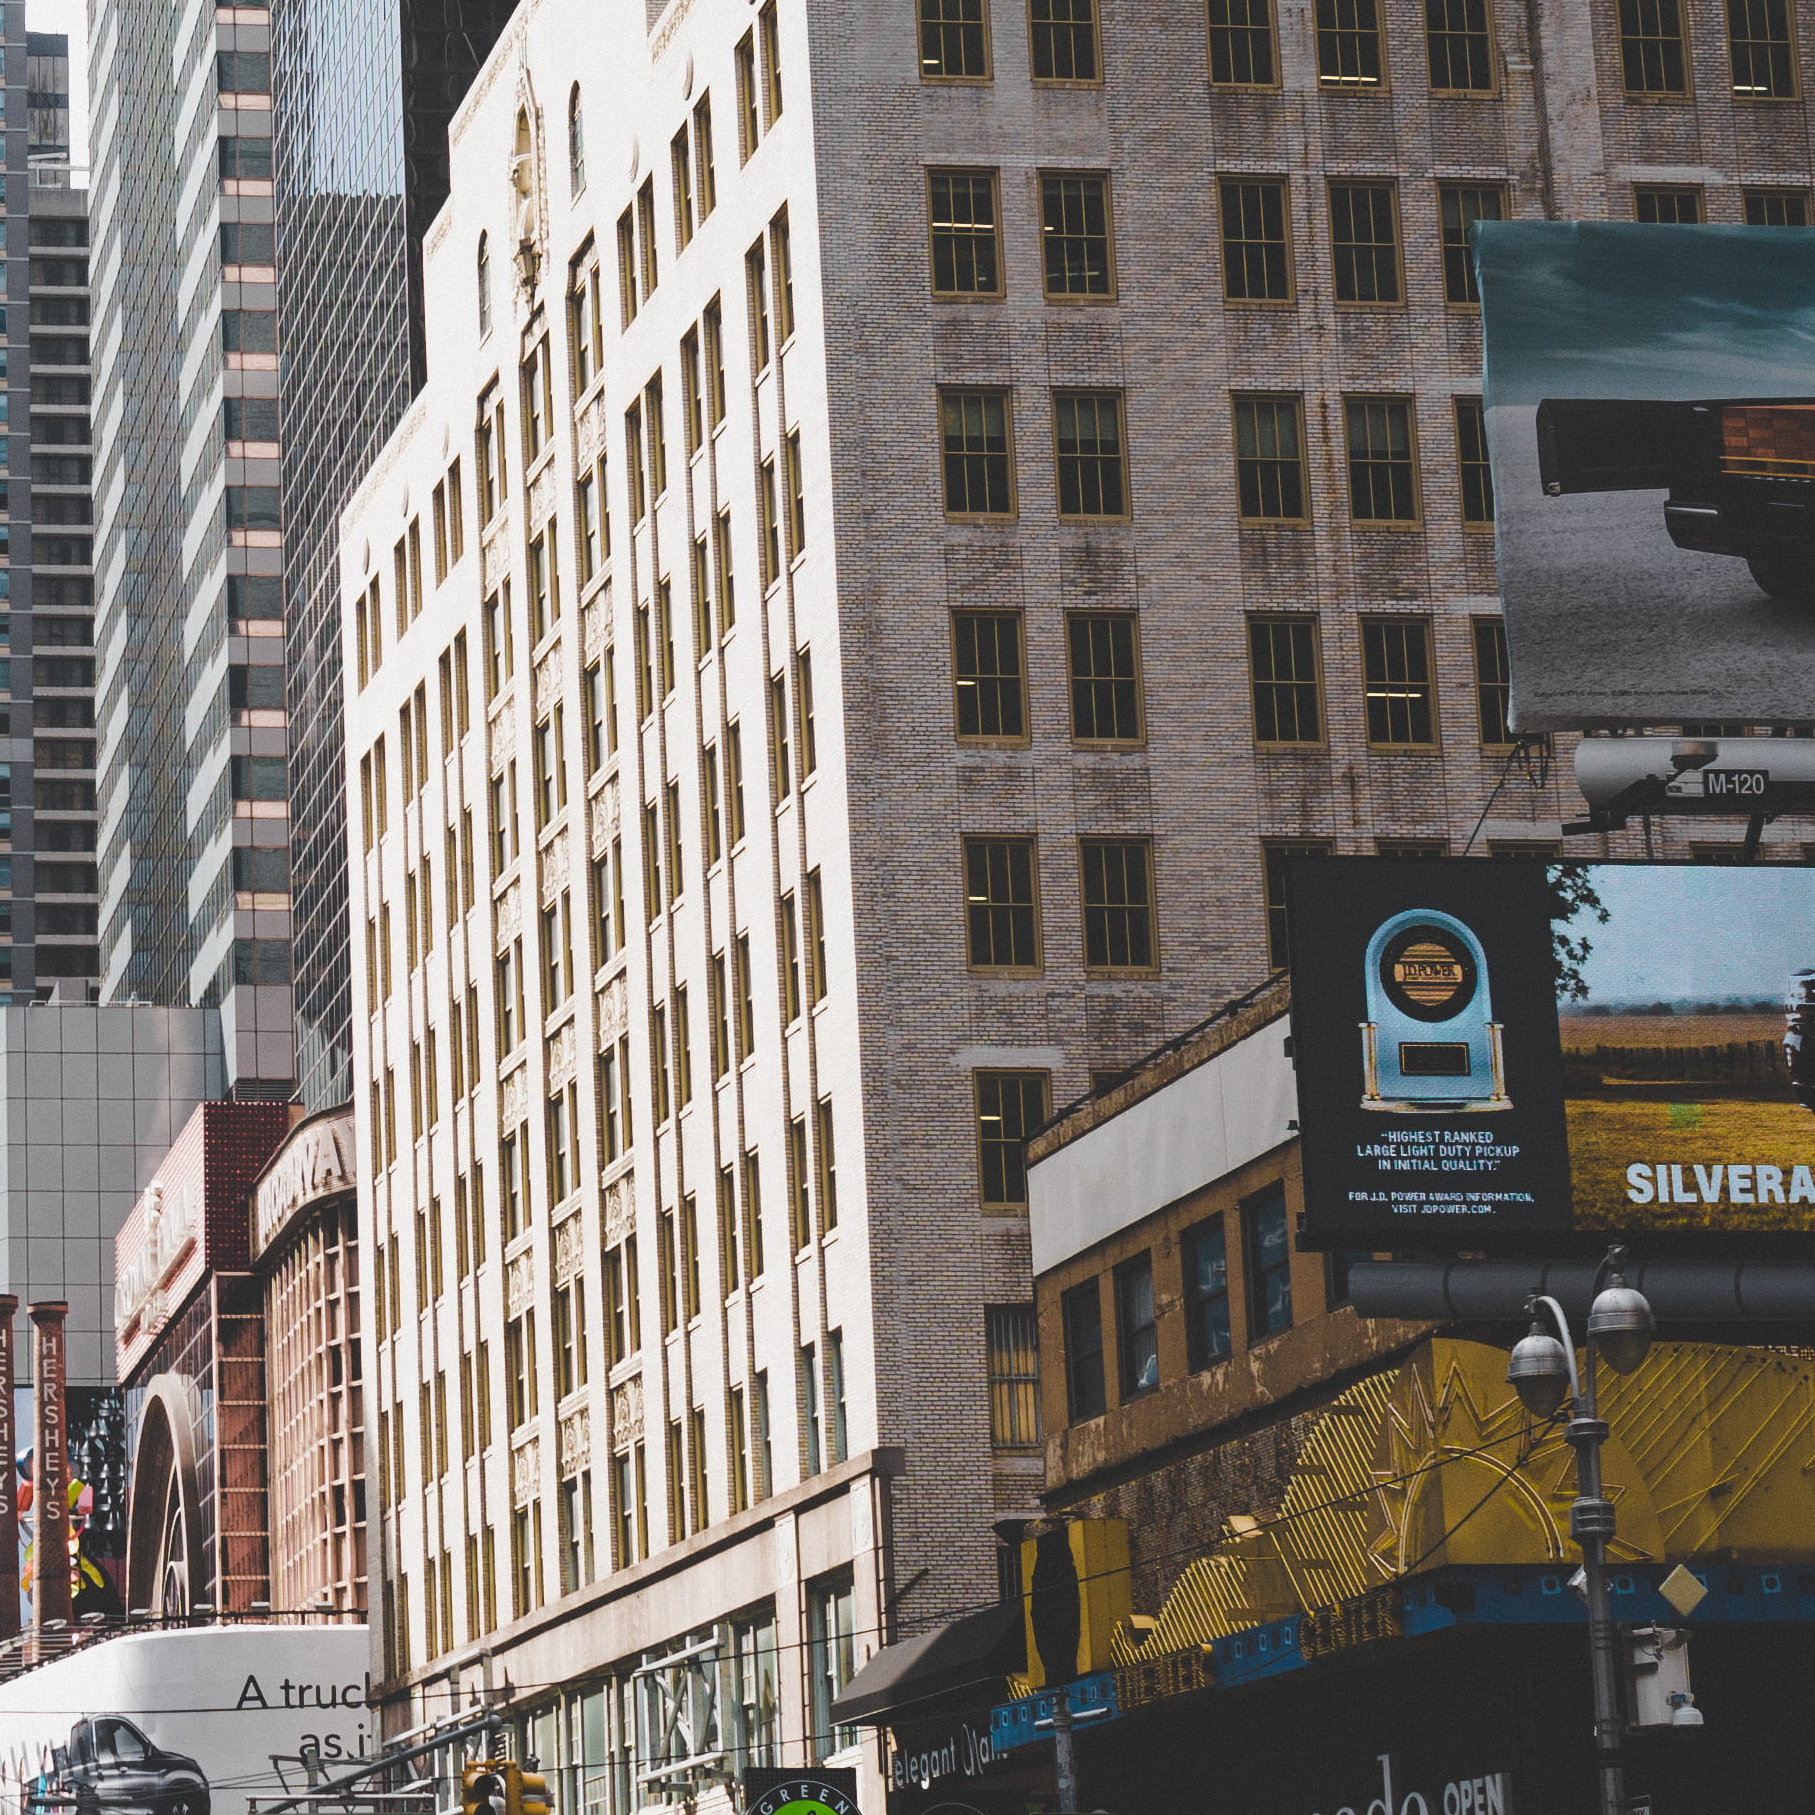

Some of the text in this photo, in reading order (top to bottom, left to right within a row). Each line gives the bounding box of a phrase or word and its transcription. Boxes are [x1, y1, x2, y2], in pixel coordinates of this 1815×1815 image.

[1708, 773, 1764, 794] M-120
[1444, 1131, 1494, 1143] RANKED
[1357, 1145, 1520, 1157] LARGE LIGHT DUTY PICKUP
[1378, 1159, 1438, 1171] IN INITIAL
[1348, 1191, 1368, 1202] FOR
[1391, 1191, 1426, 1202] POWER
[1429, 1191, 1464, 1202] AWARD
[1392, 1204, 1417, 1214] VISIT
[236, 1674, 269, 1709] A
[300, 1733, 342, 1760] as
[894, 1737, 956, 1790] elegant
